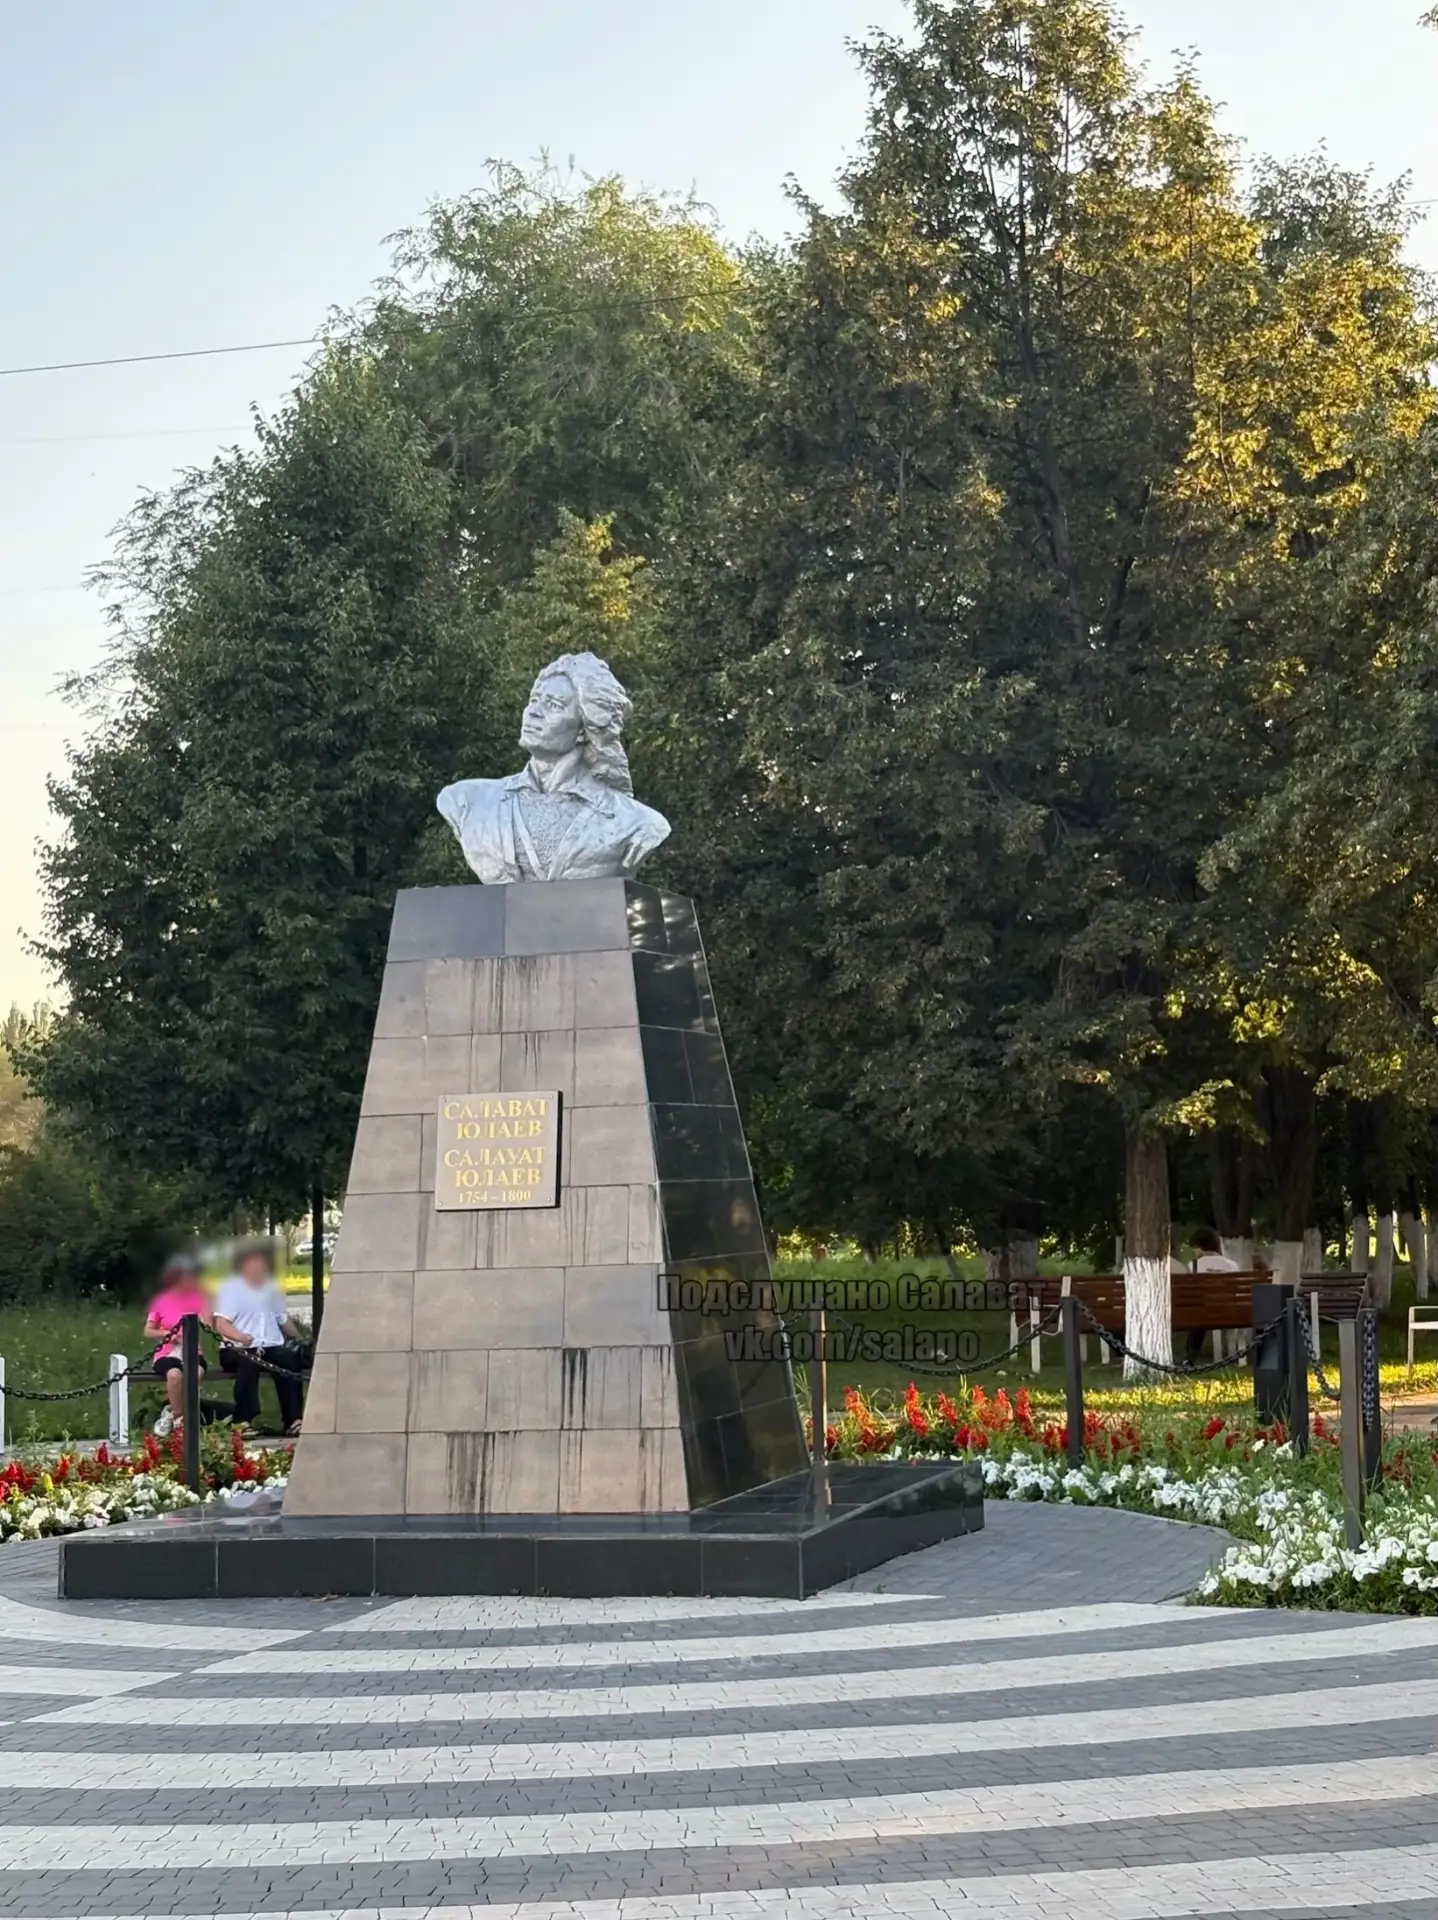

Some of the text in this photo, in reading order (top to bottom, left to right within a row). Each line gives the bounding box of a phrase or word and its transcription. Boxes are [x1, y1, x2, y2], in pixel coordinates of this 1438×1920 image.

[445, 1100, 547, 1119] САЛАВАТ
[456, 1120, 543, 1140] ЮЛАЕВ
[445, 1147, 546, 1166] САЛАУАТ
[455, 1167, 541, 1187] ЮЛАЕВ
